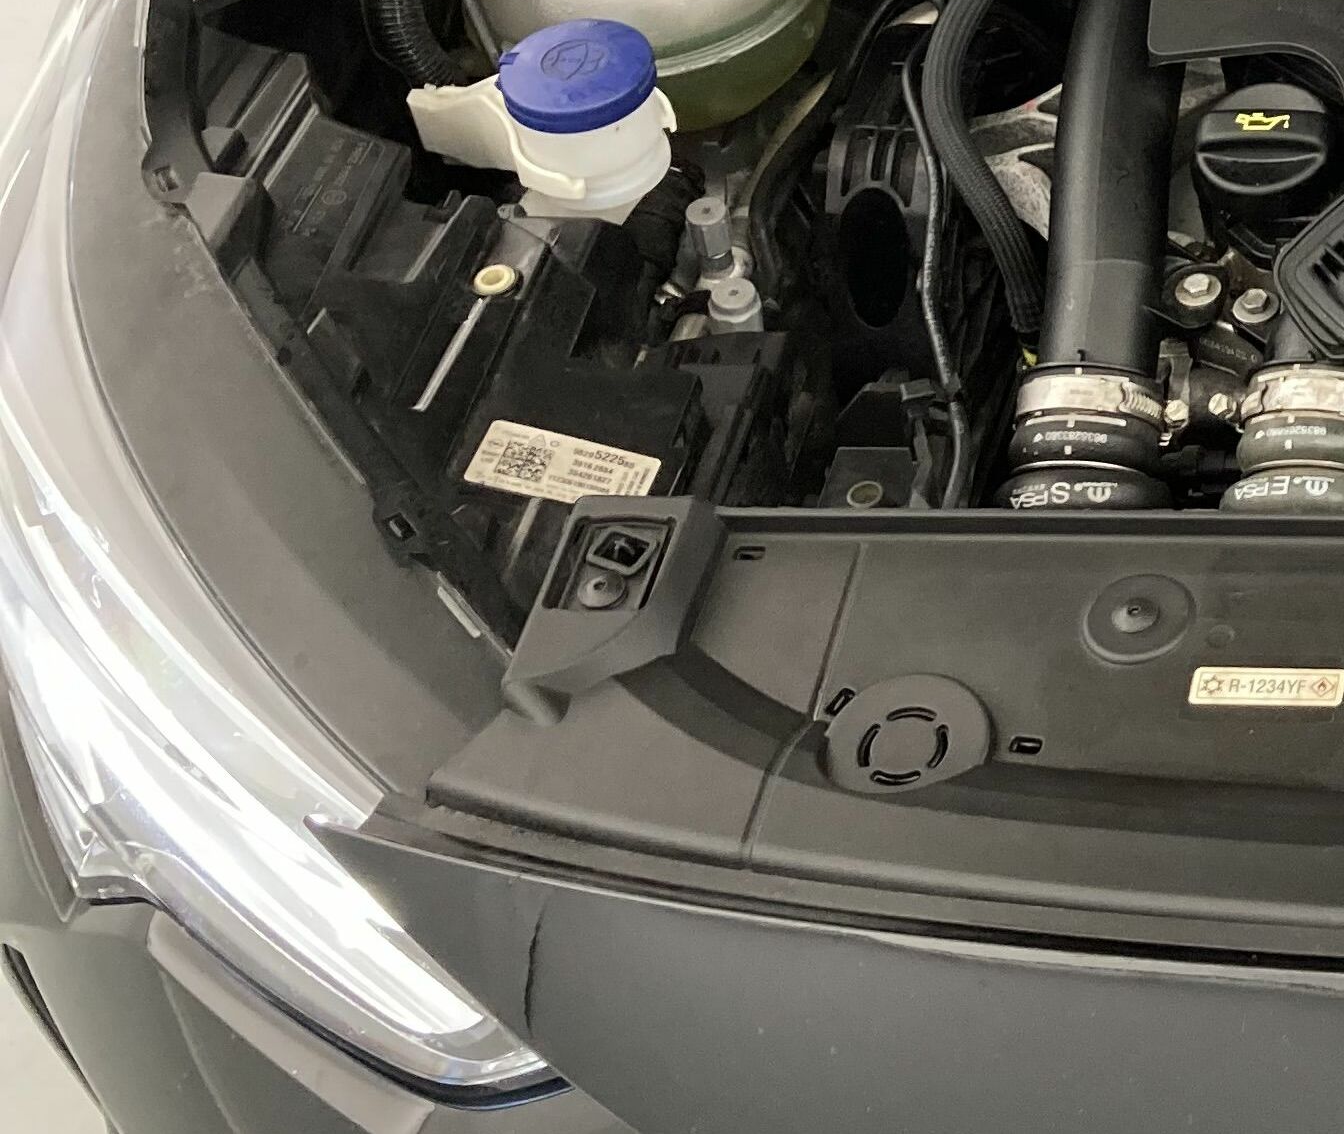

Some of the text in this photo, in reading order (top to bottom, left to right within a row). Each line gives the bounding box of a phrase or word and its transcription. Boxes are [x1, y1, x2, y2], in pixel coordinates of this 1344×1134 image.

[1050, 481, 1071, 504] S
[1234, 481, 1270, 500] PSA
[1270, 474, 1291, 496] E
[1009, 489, 1049, 509] PSA
[1228, 677, 1308, 695] R-1234YF
